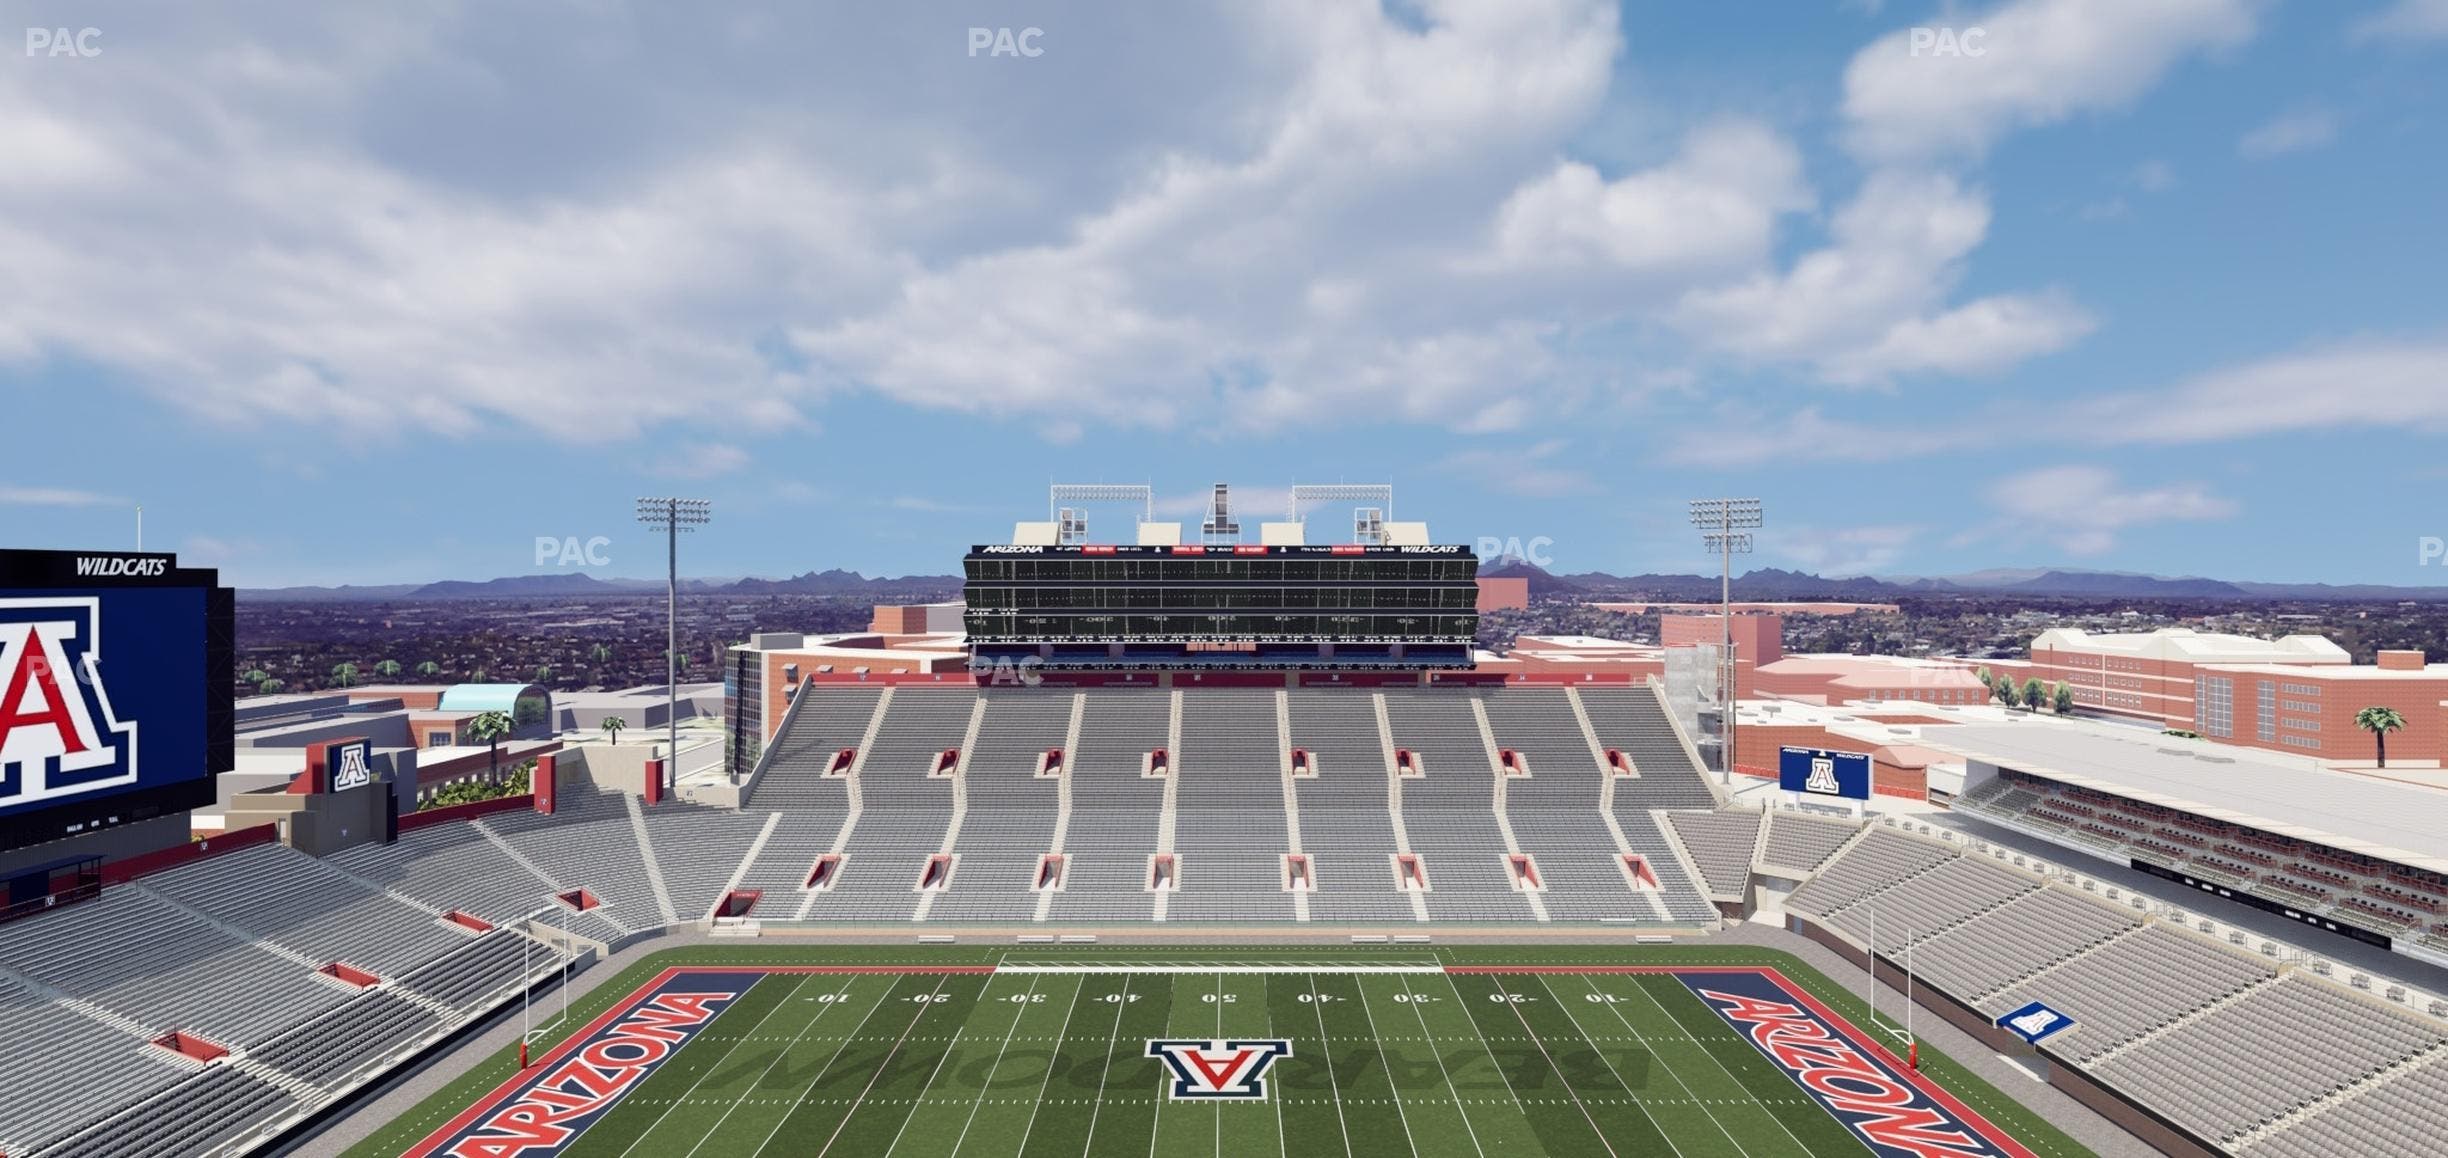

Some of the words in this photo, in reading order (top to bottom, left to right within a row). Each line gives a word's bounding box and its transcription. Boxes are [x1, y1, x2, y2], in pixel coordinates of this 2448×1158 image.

[983, 545, 1044, 554] ARIZONA
[1400, 545, 1460, 554] WILDCATS
[76, 557, 167, 576] WILDCATS
[334, 744, 370, 792] A
[1806, 758, 1839, 794] A
[818, 994, 851, 1003] 10
[914, 994, 951, 1003] 20
[1010, 994, 1046, 1003] 30
[1106, 994, 1142, 1003] 40
[1202, 994, 1237, 1003] 50
[1297, 994, 1334, 1003] 40
[1393, 994, 1429, 1003] 30
[1489, 994, 1525, 1003] 20
[1585, 994, 1618, 1003] 10
[694, 1050, 1166, 1091] DOWN
[1144, 1039, 1294, 1100] A
[1279, 1050, 1651, 1091] BEAR
